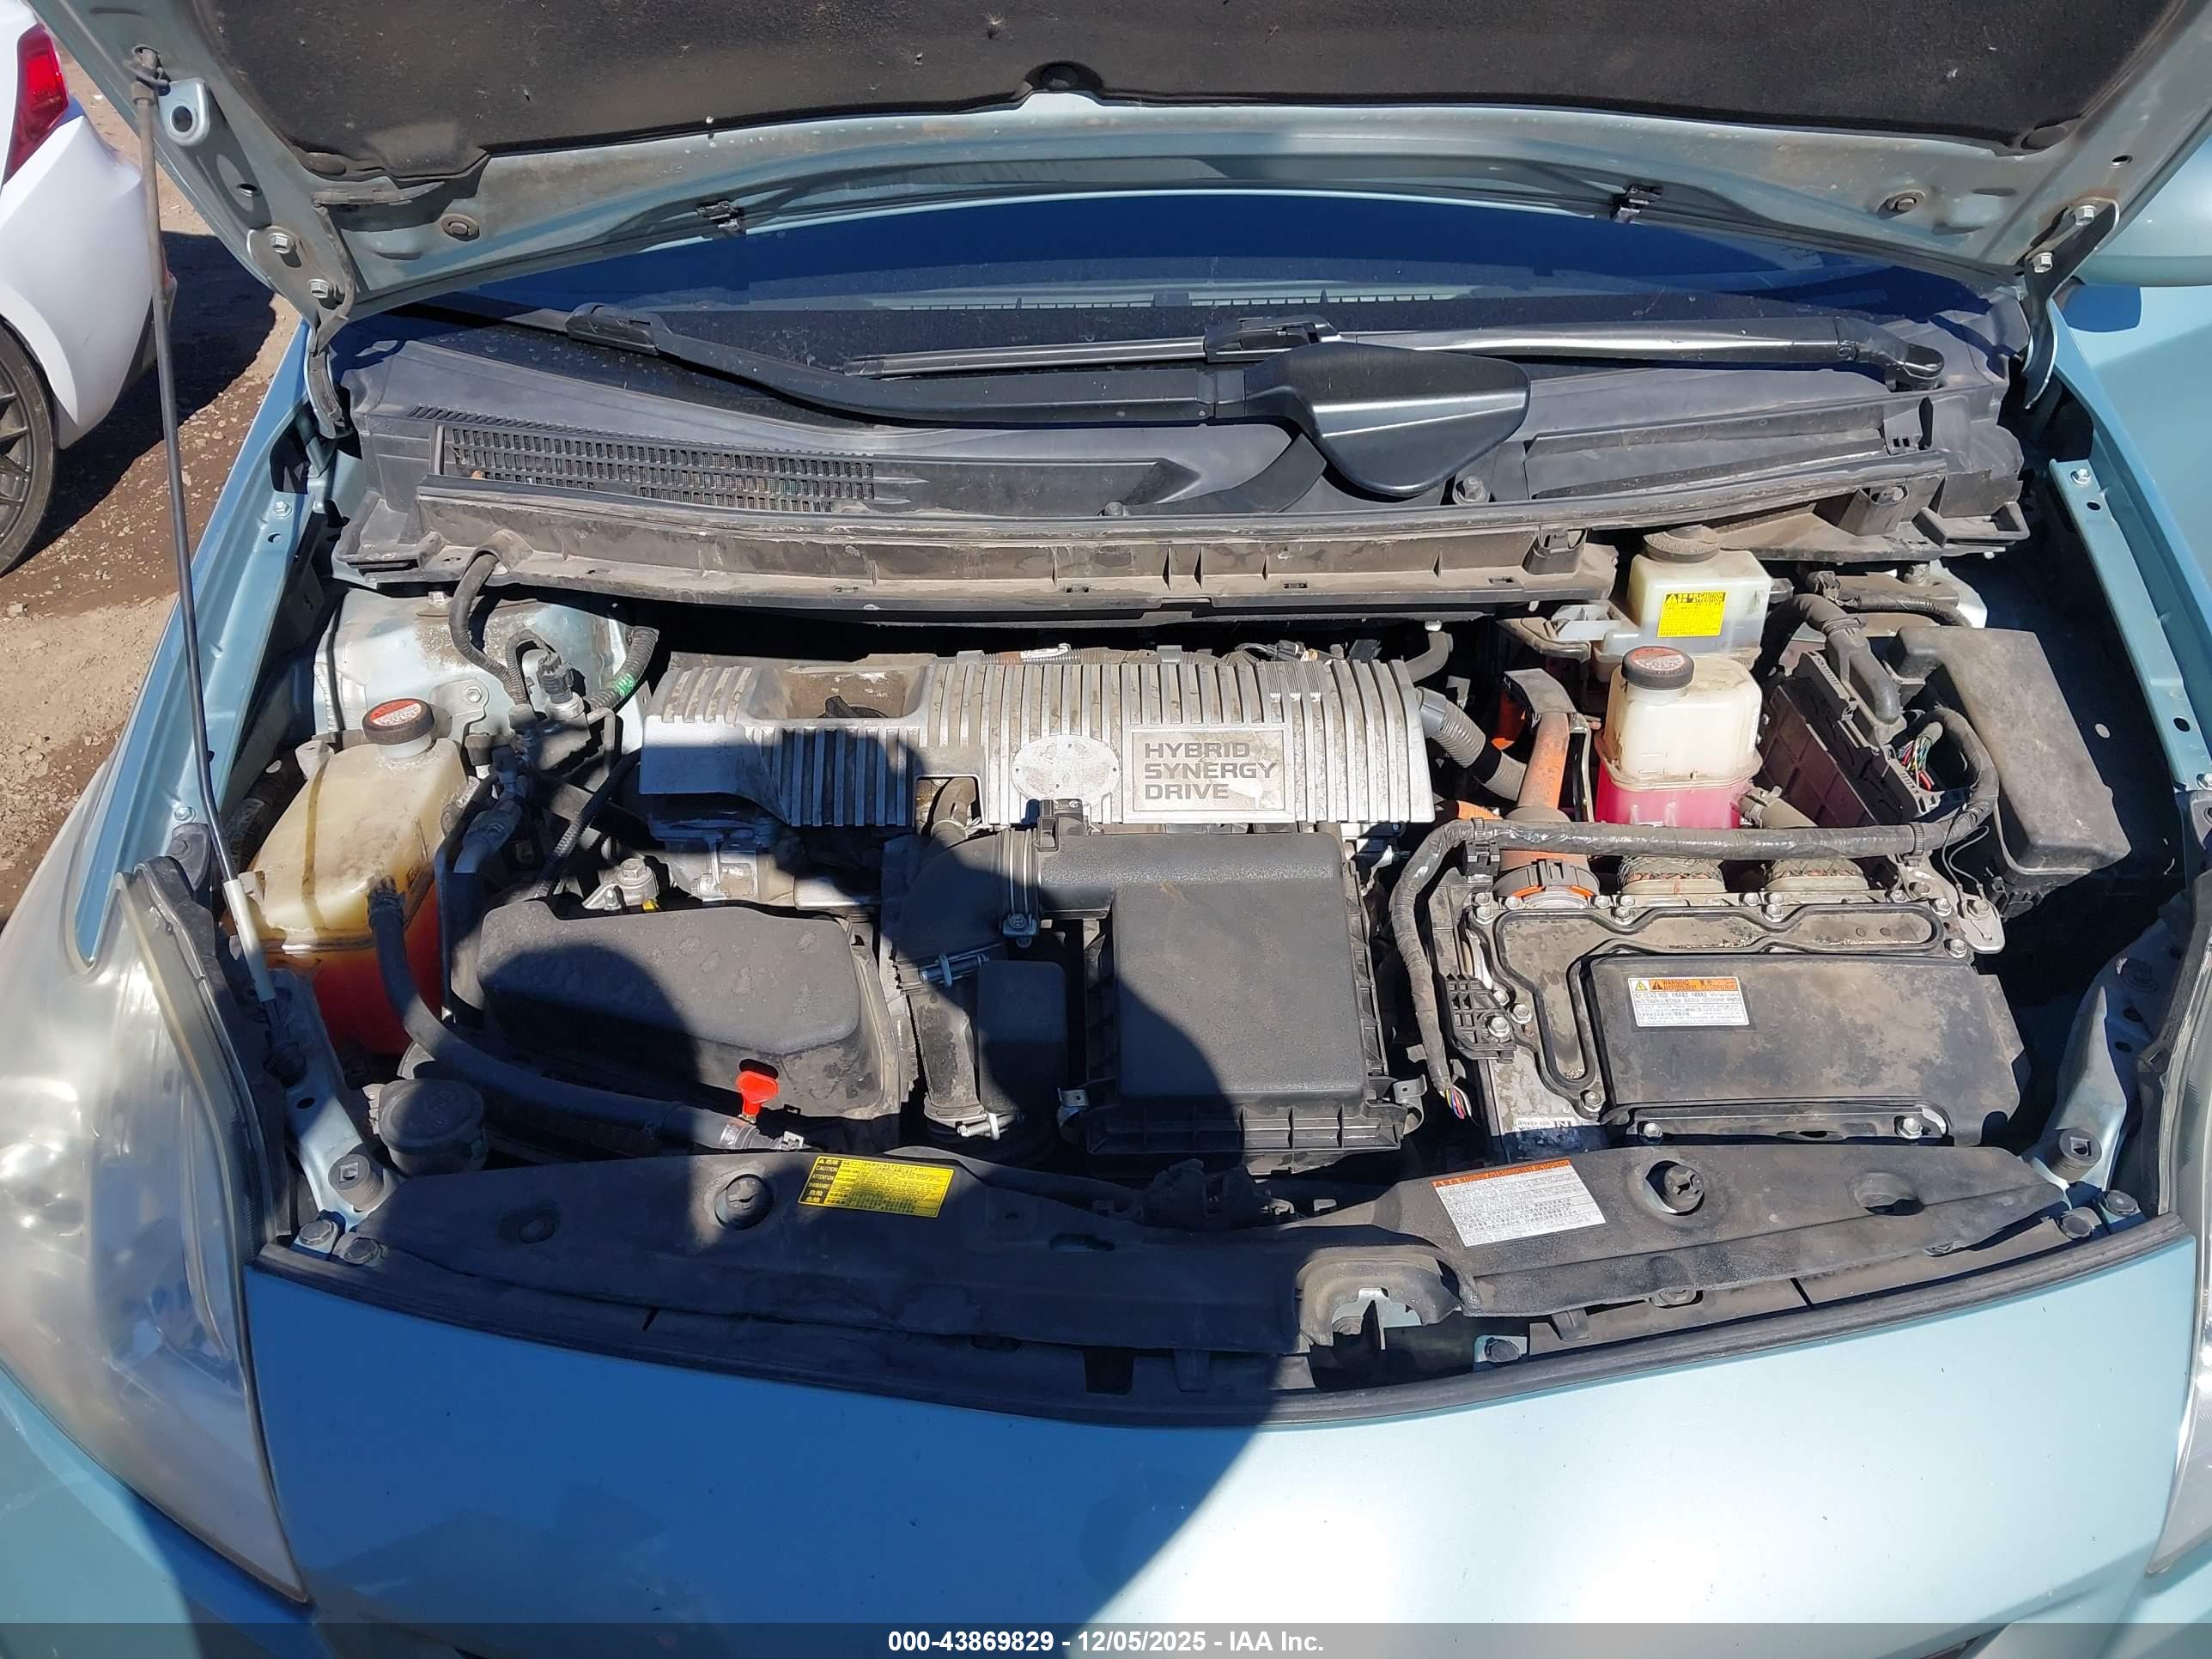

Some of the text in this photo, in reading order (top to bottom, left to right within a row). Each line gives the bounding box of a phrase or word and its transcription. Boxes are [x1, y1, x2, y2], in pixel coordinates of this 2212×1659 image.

[1145, 743, 1250, 758] HYBRID
[1145, 763, 1277, 779] SYNERGY
[1145, 783, 1229, 799] DRIVE
